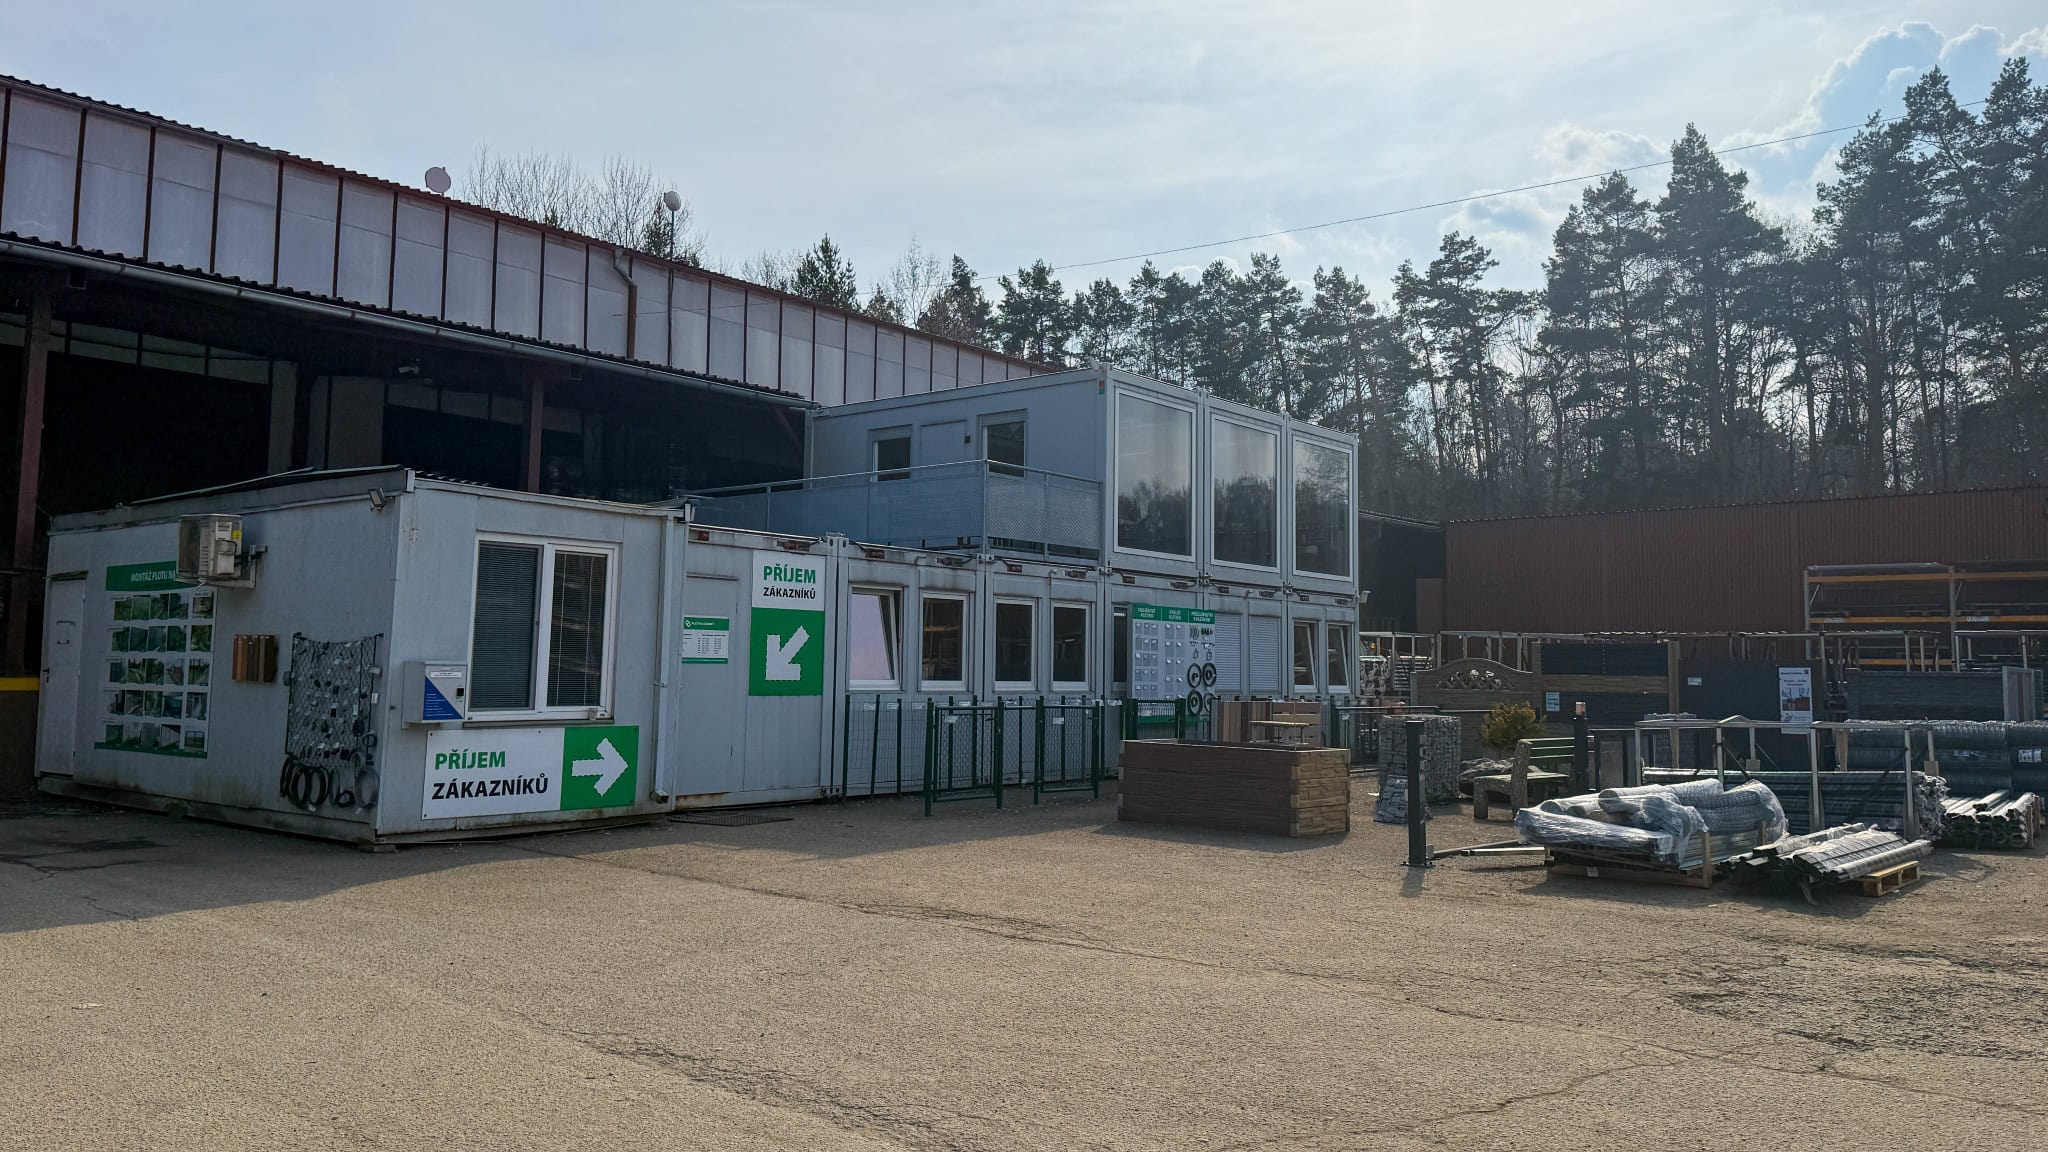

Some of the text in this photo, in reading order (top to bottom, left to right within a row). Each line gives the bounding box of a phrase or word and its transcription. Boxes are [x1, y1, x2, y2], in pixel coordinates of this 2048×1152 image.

[130, 569, 151, 582] MONTÁŽ
[152, 569, 168, 581] PLOTU
[763, 563, 816, 584] PŘÍJEM
[763, 585, 816, 599] ZÁKAZNÍKŮ
[435, 748, 506, 769] PŘÍJEM
[432, 773, 548, 799] ZÁKAZNÍKŮ
